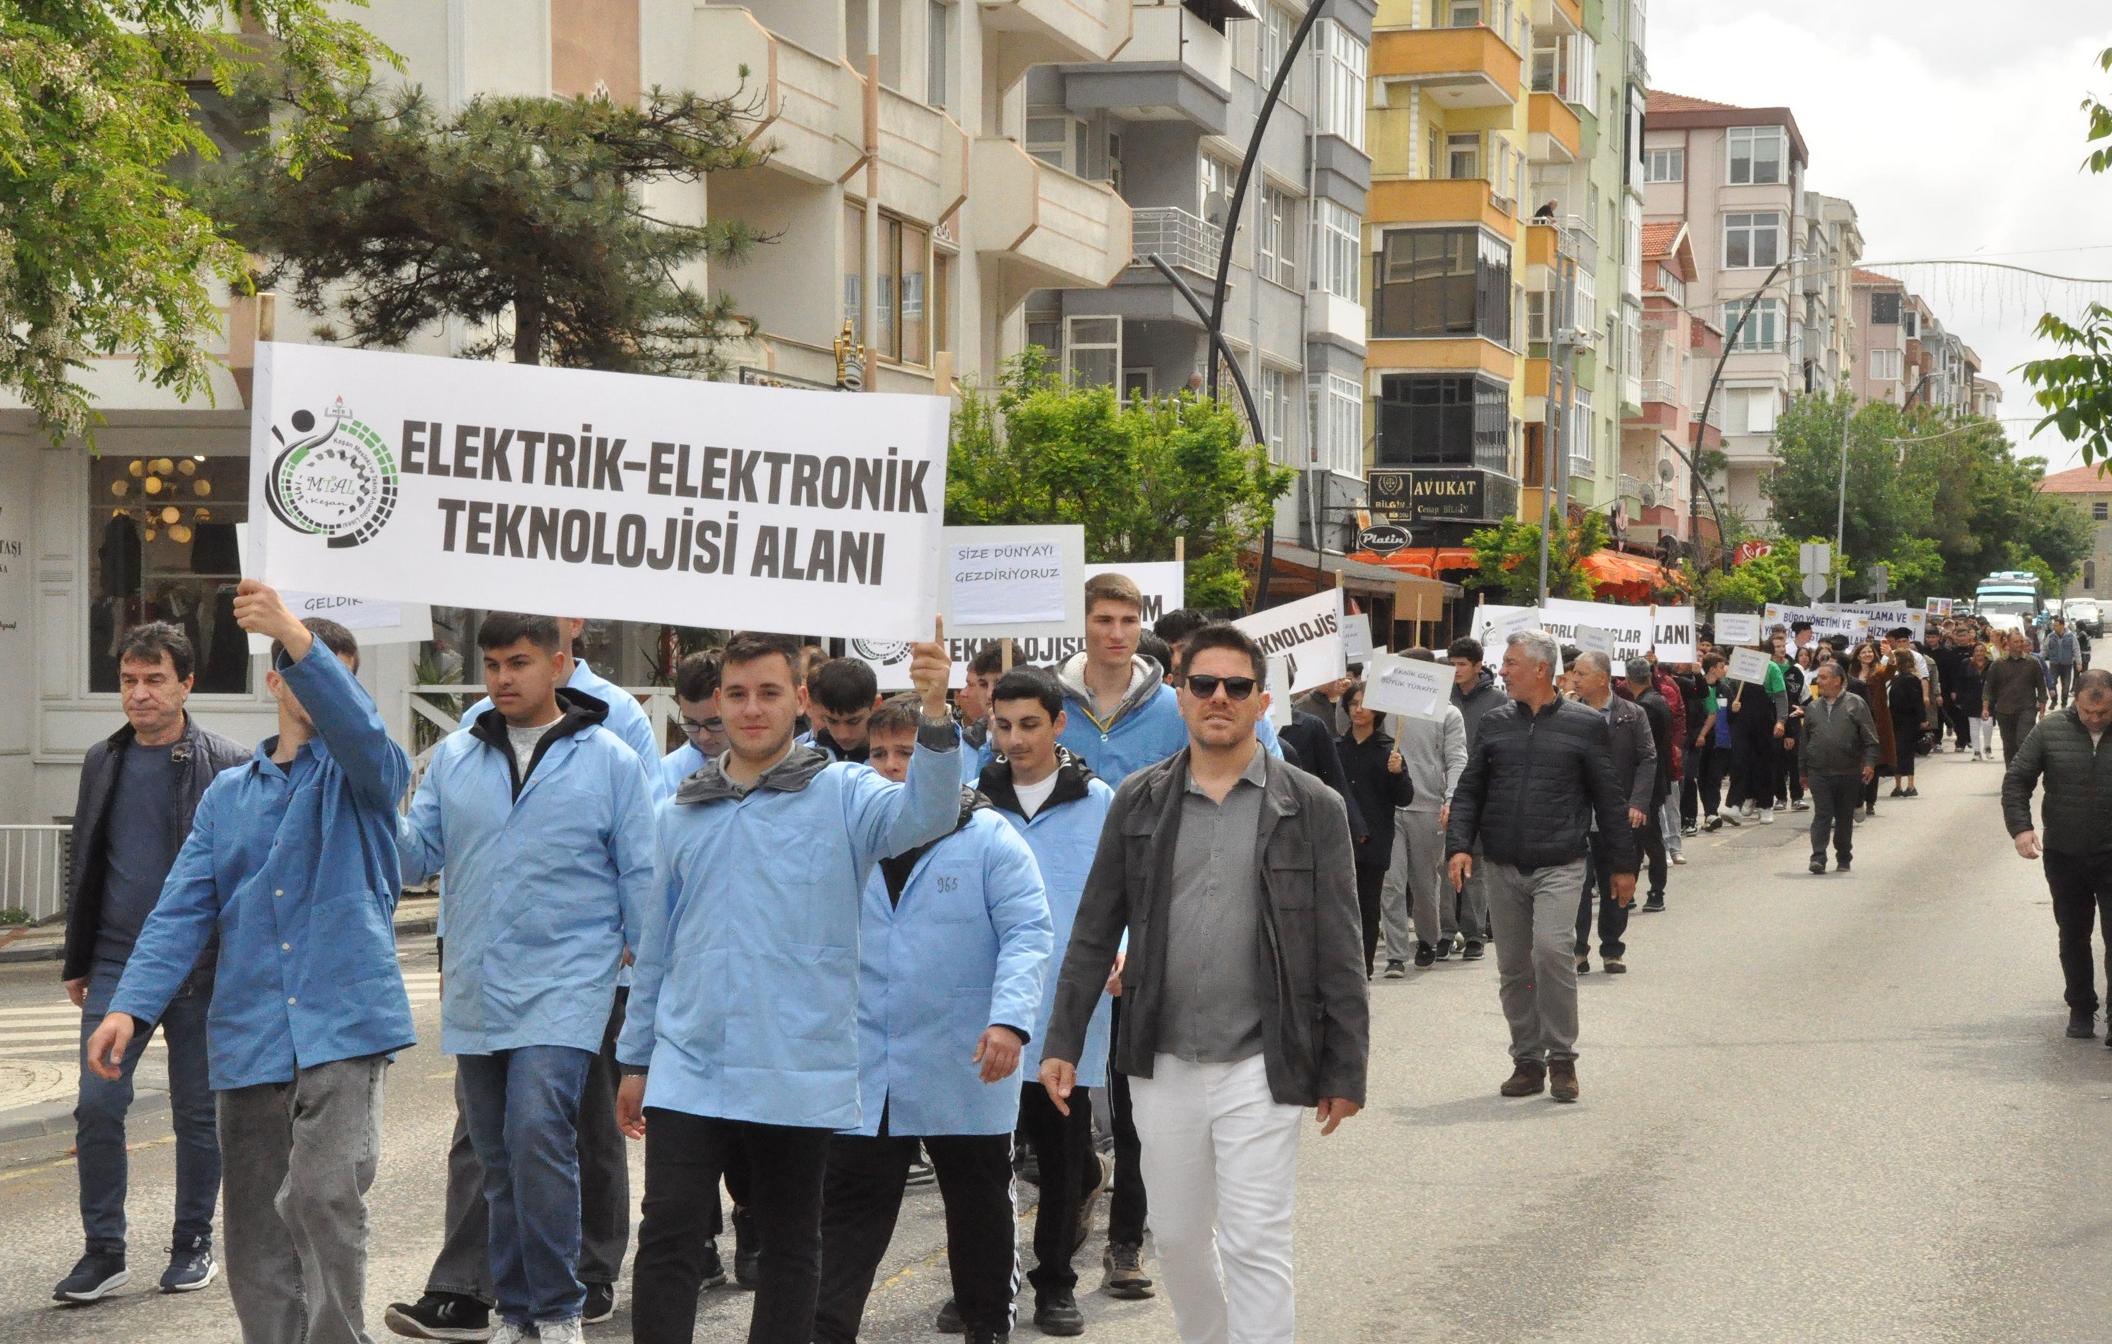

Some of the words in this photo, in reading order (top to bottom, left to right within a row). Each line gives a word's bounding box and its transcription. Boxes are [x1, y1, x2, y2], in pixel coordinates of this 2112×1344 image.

[401, 419, 930, 514] ELEKTRİK-ELEKTRONİK
[1414, 481, 1476, 496] AVUKAT
[437, 497, 739, 576] TEKNOLOJİSİ
[750, 525, 886, 586] ALANI
[1362, 532, 1405, 544] Platin
[958, 547, 989, 560] SİZE
[994, 544, 1053, 558] DÜNYAYI
[955, 567, 1060, 583] GEZDİRİYORUZ
[1654, 624, 1690, 645] LANI
